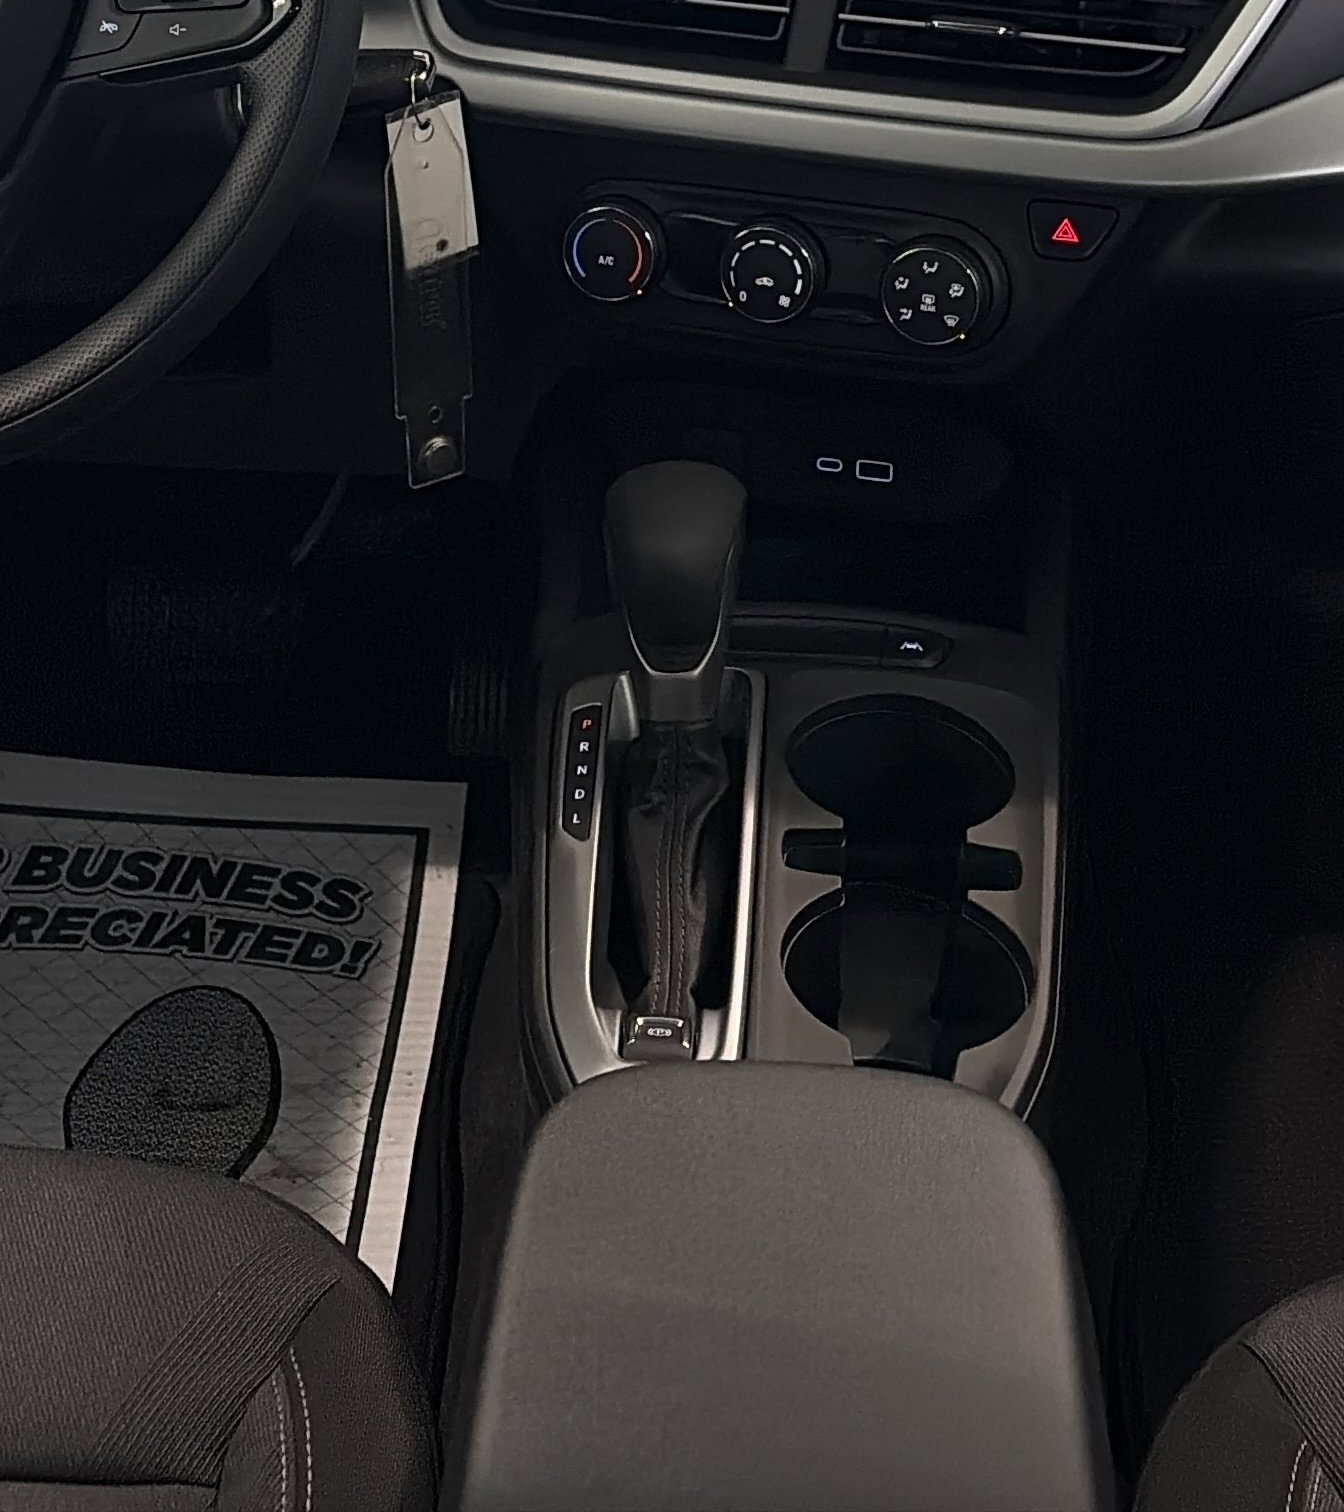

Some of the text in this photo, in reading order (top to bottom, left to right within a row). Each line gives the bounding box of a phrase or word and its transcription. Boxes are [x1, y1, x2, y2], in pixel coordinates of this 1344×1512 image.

[598, 255, 614, 266] A/C
[582, 719, 592, 729] P
[579, 742, 590, 753] R
[577, 765, 588, 776] N
[574, 789, 585, 800] D
[572, 813, 581, 824] L
[12, 844, 368, 920] BUSINESS
